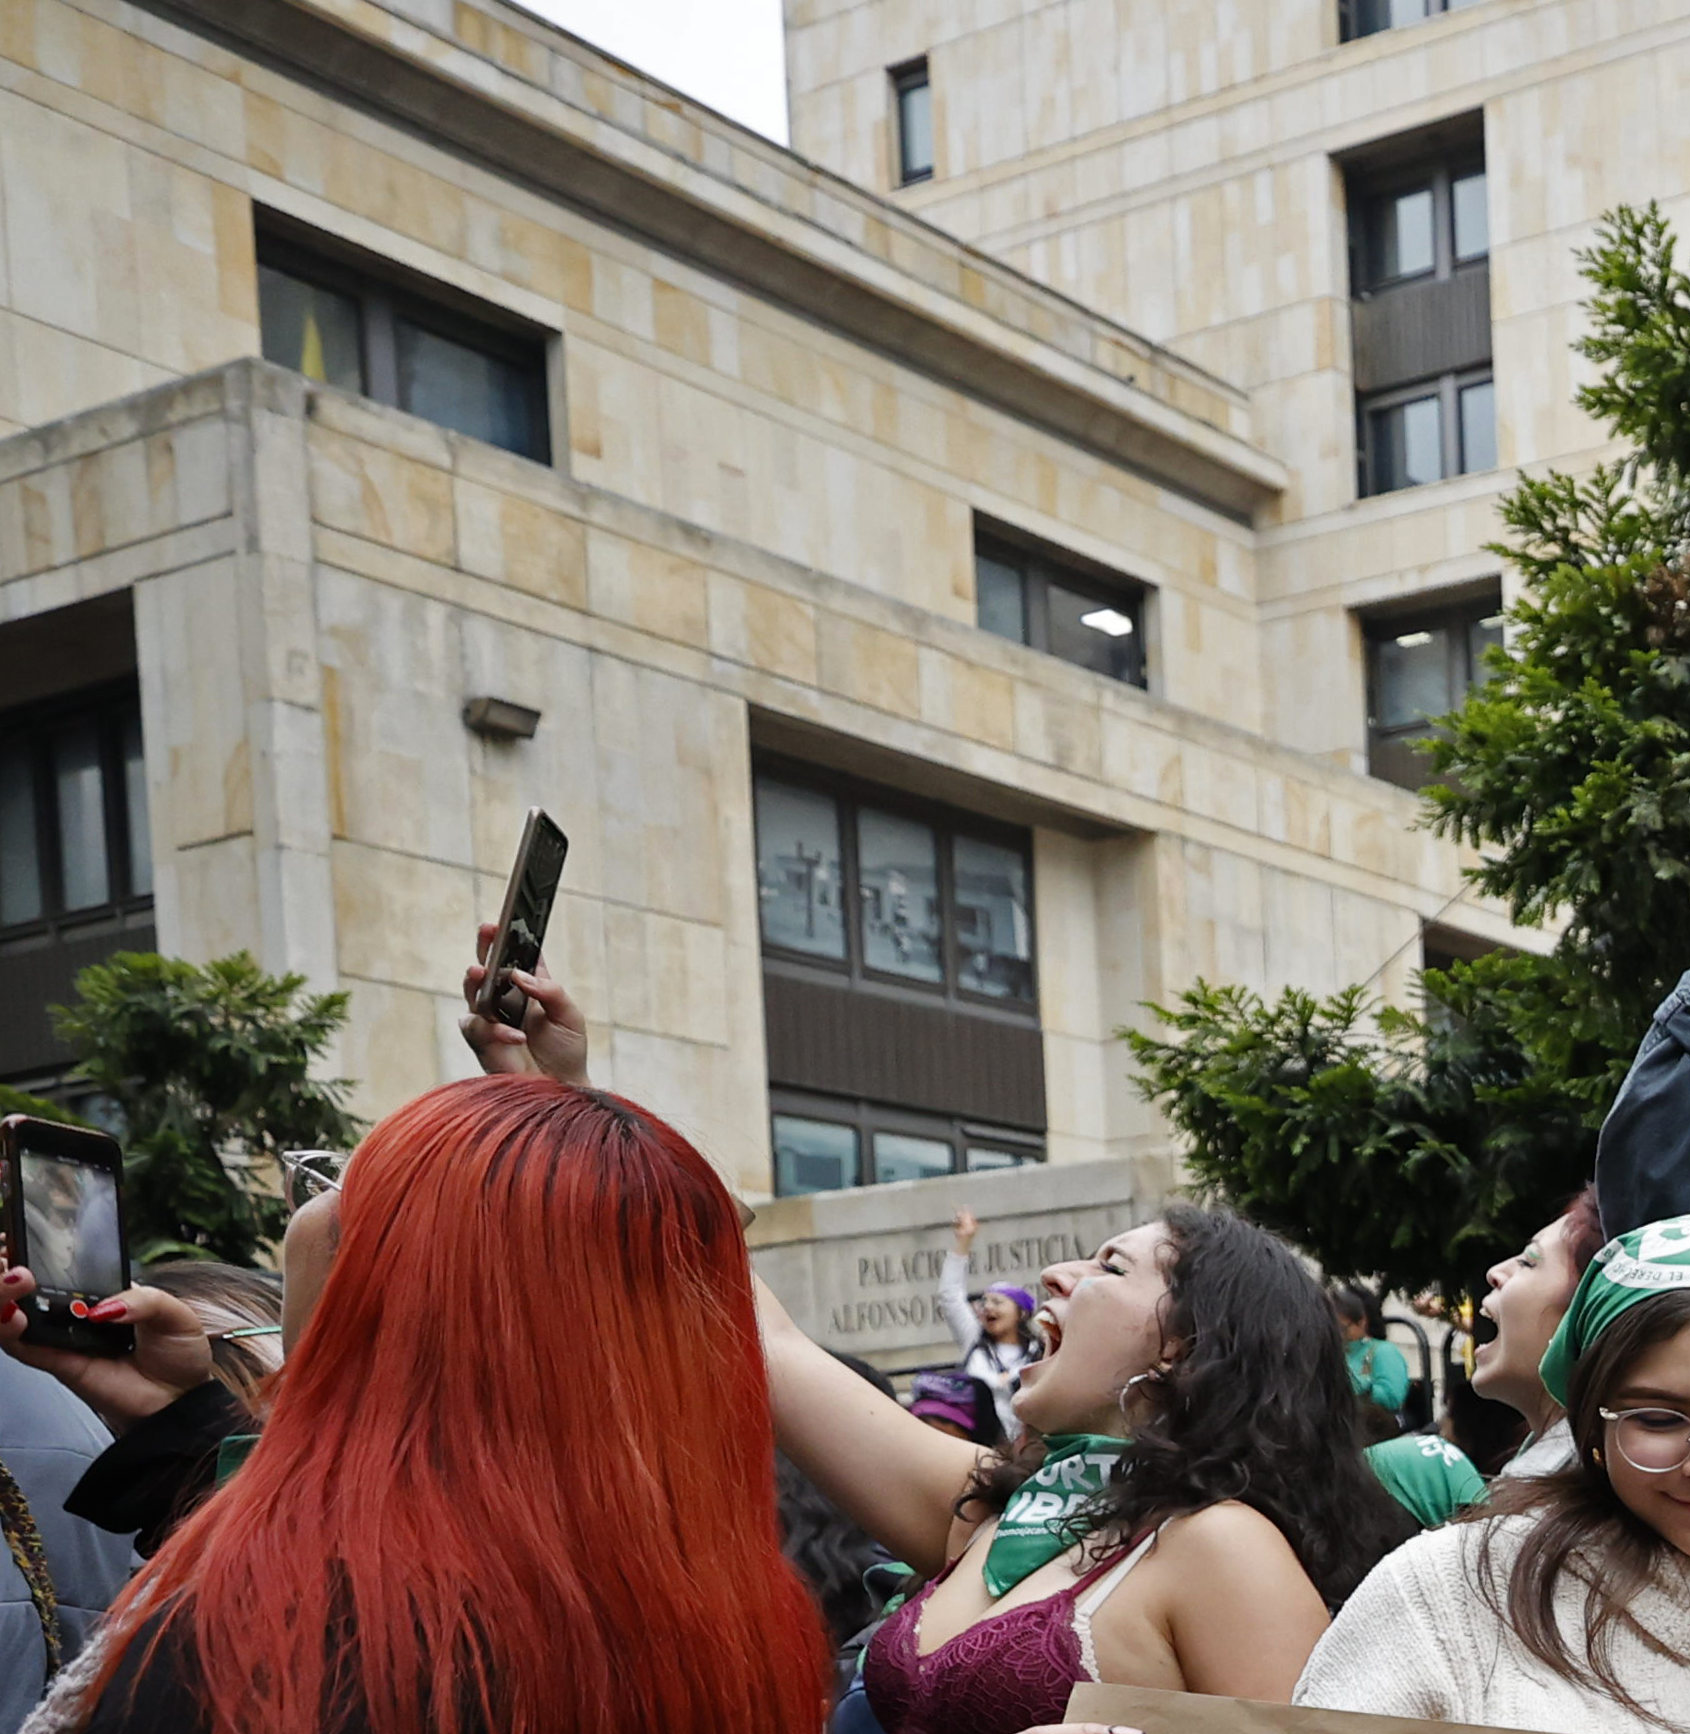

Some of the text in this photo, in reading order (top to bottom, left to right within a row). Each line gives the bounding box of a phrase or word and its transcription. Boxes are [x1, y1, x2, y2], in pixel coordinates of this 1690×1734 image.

[983, 1234, 1085, 1273] JUSTICIA
[1669, 1271, 1683, 1281] EL
[829, 1298, 924, 1334] ALFONSO
